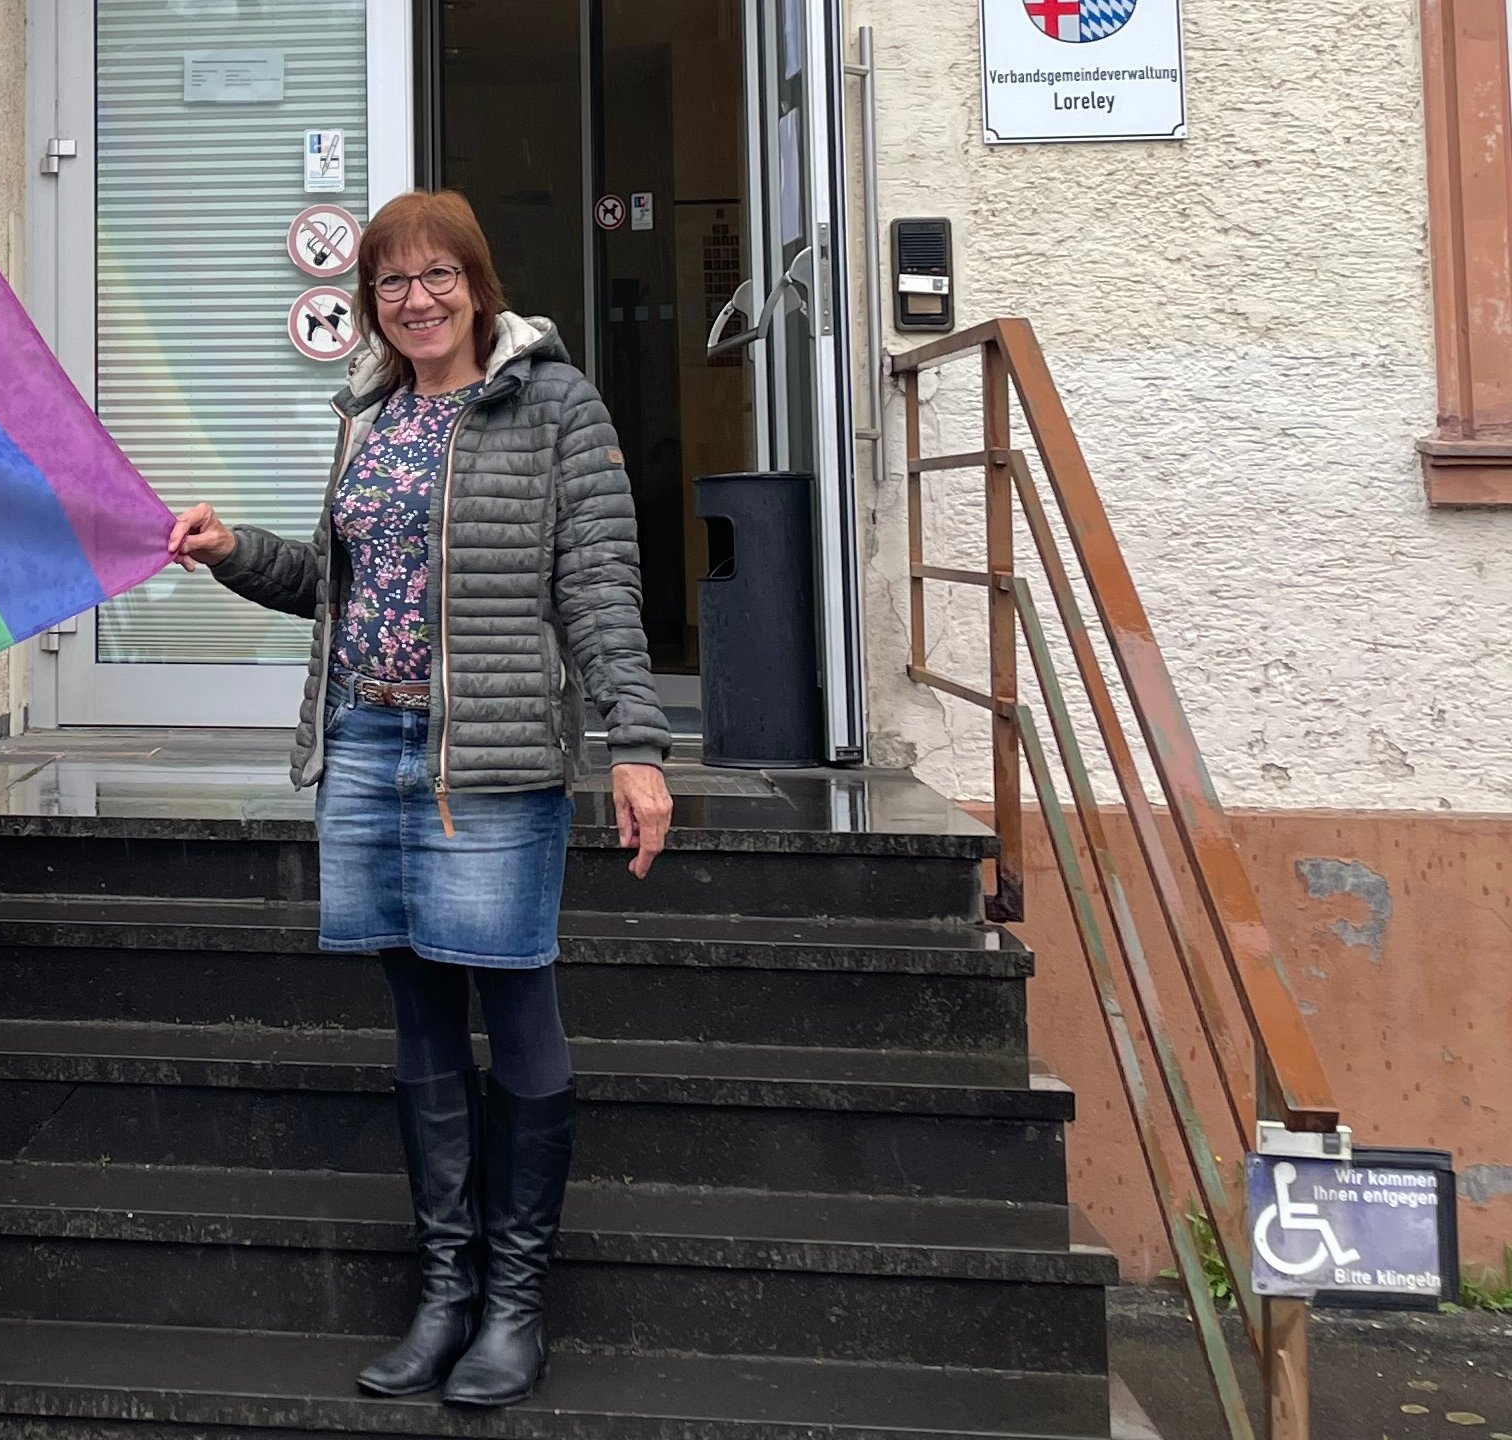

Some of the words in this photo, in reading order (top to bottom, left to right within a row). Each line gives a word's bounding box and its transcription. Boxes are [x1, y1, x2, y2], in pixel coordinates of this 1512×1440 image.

[989, 66, 1178, 86] Verbandsgemeindeverwaltung
[1053, 91, 1116, 114] Loreley
[1334, 1168, 1364, 1185] Wir
[1367, 1169, 1438, 1187] kommen
[1313, 1185, 1358, 1202] Ihnen
[1362, 1189, 1438, 1208] entgegen
[1334, 1268, 1372, 1285] Bitte
[1375, 1269, 1442, 1290] klingeln
